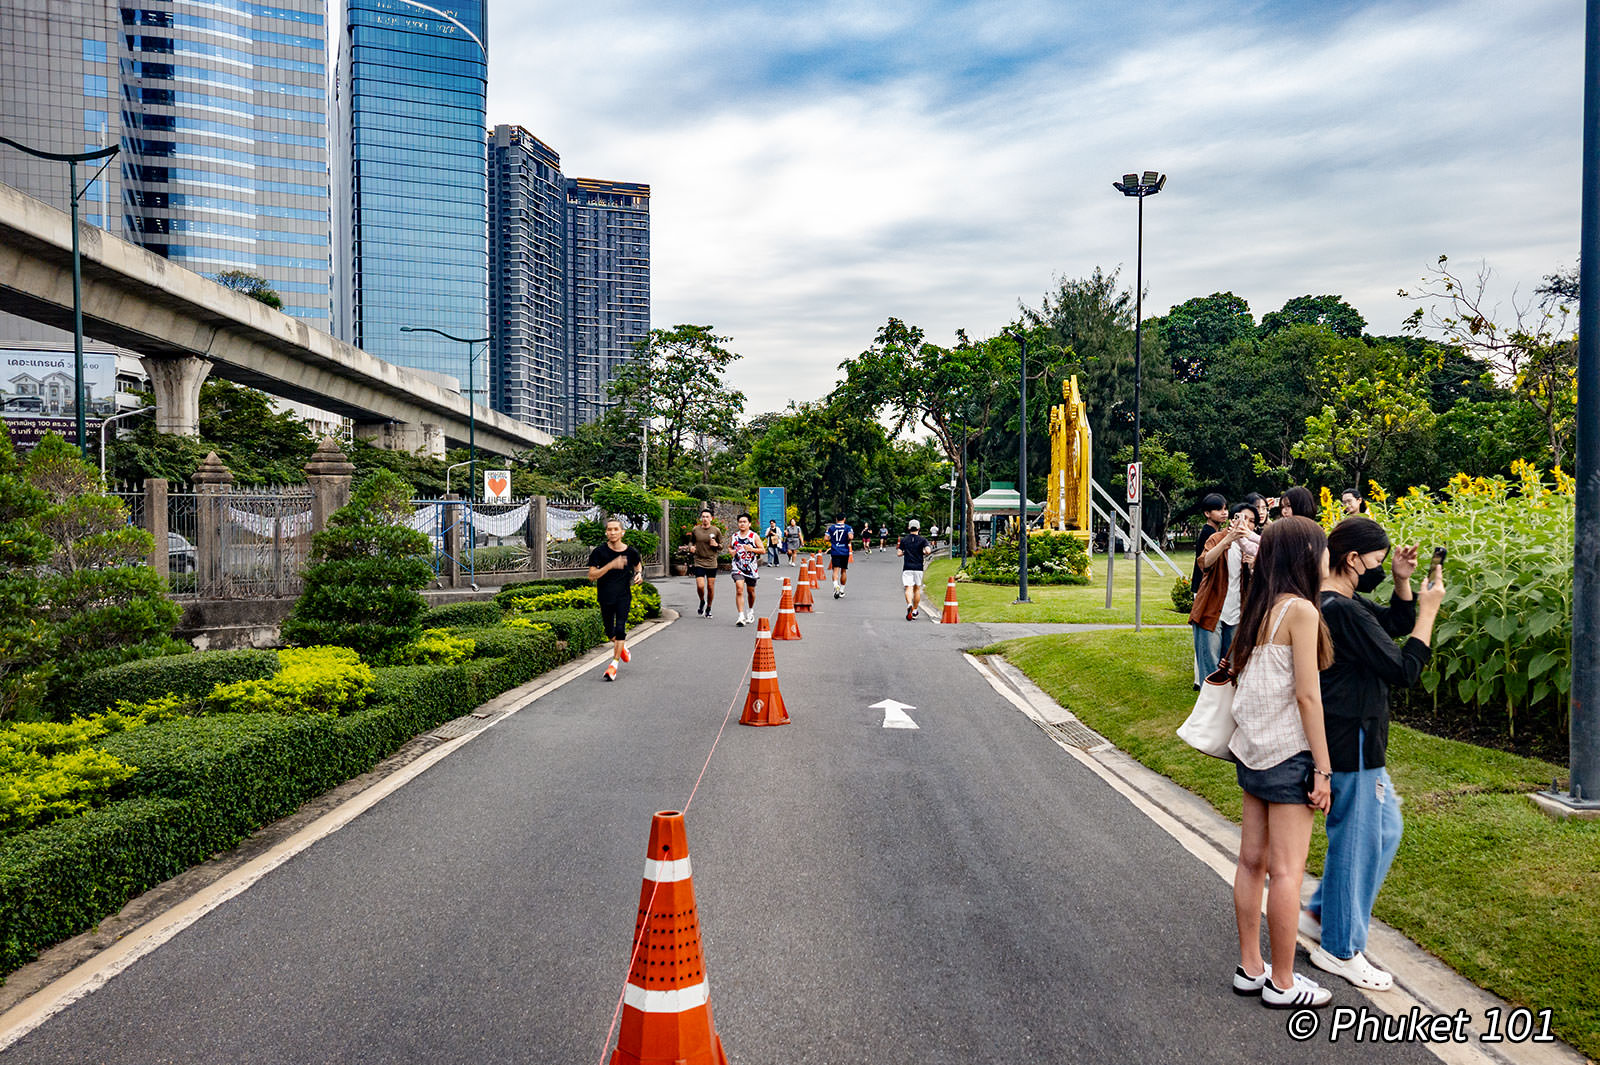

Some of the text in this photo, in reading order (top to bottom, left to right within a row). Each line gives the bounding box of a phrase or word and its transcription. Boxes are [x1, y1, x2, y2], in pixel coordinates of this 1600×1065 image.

[7, 359, 65, 369] เดอะแกรนด์
[833, 529, 845, 542] 17
[741, 551, 752, 560] 23
